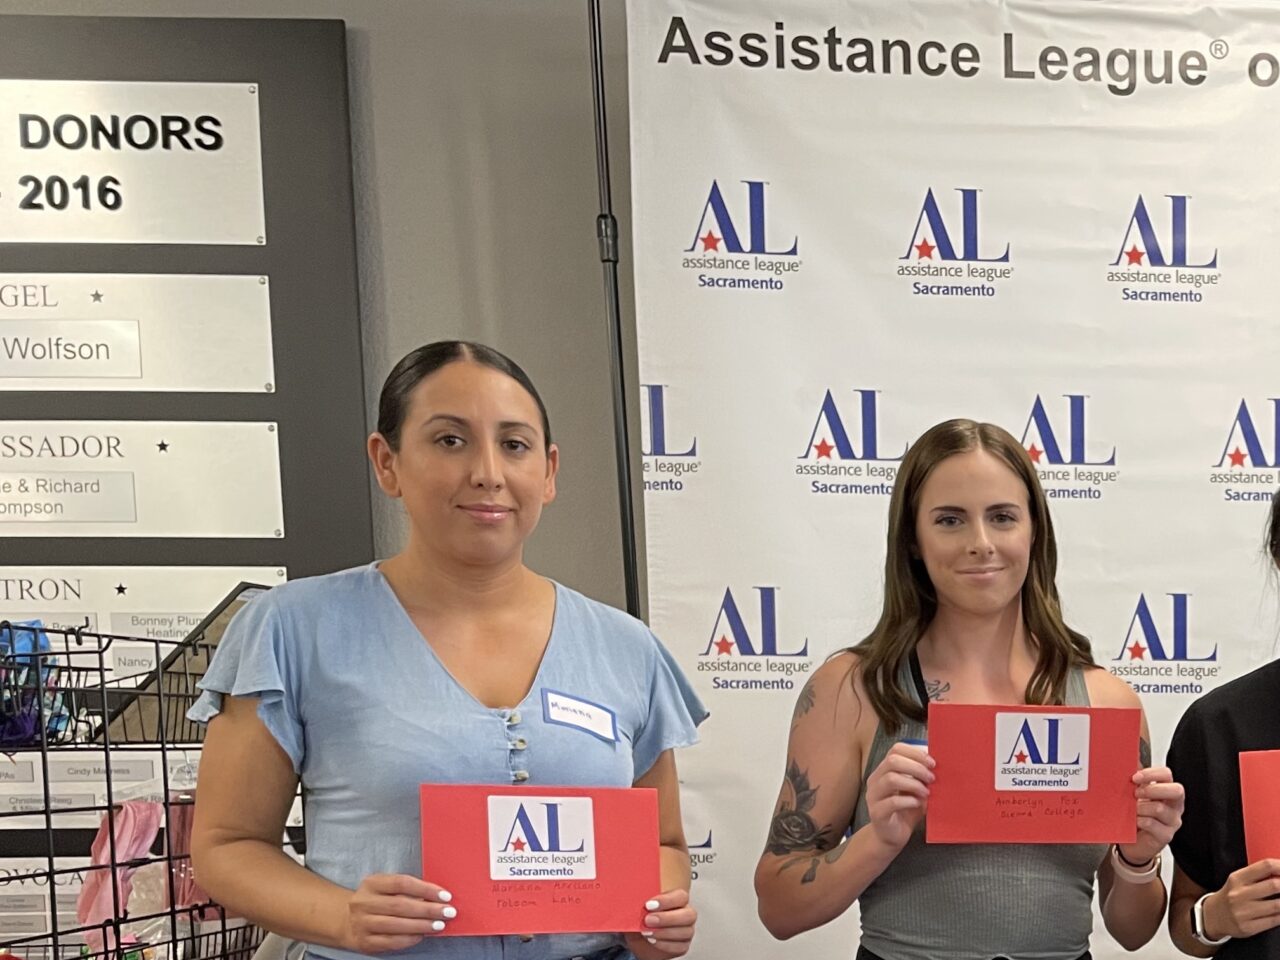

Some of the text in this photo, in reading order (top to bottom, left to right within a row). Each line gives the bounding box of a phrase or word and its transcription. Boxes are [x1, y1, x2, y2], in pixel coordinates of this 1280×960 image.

[657, 16, 981, 78] Assistance
[18, 113, 225, 152] DONORS
[18, 175, 123, 211] 2016
[684, 179, 798, 256] AL
[899, 187, 1010, 263] AL
[1108, 193, 1217, 269] AL
[682, 256, 750, 271] assistance
[897, 262, 962, 278] assistance
[698, 275, 783, 291] Sacramento
[1107, 269, 1172, 284] assistance
[913, 282, 995, 298] Sacramento
[1122, 288, 1202, 303] Sacramento
[3, 337, 110, 360] Wolfson
[797, 388, 908, 461] AL
[1021, 393, 1116, 466] AL
[795, 461, 862, 476] assistance
[1210, 470, 1274, 484] assistance
[36, 478, 100, 494] Richard
[699, 586, 808, 656] AL
[1112, 592, 1218, 662] AL
[117, 657, 153, 668] Nancy
[697, 657, 763, 673] assistance
[1110, 663, 1173, 677] assistance
[712, 676, 794, 691] Sacramento
[1127, 681, 1203, 694] acramento
[1002, 717, 1081, 764] AL
[1001, 766, 1048, 775] assistance
[1011, 777, 1069, 787] Sacramento
[498, 802, 584, 852] AL
[497, 854, 549, 864] assistance
[509, 866, 574, 876] Sacramento
